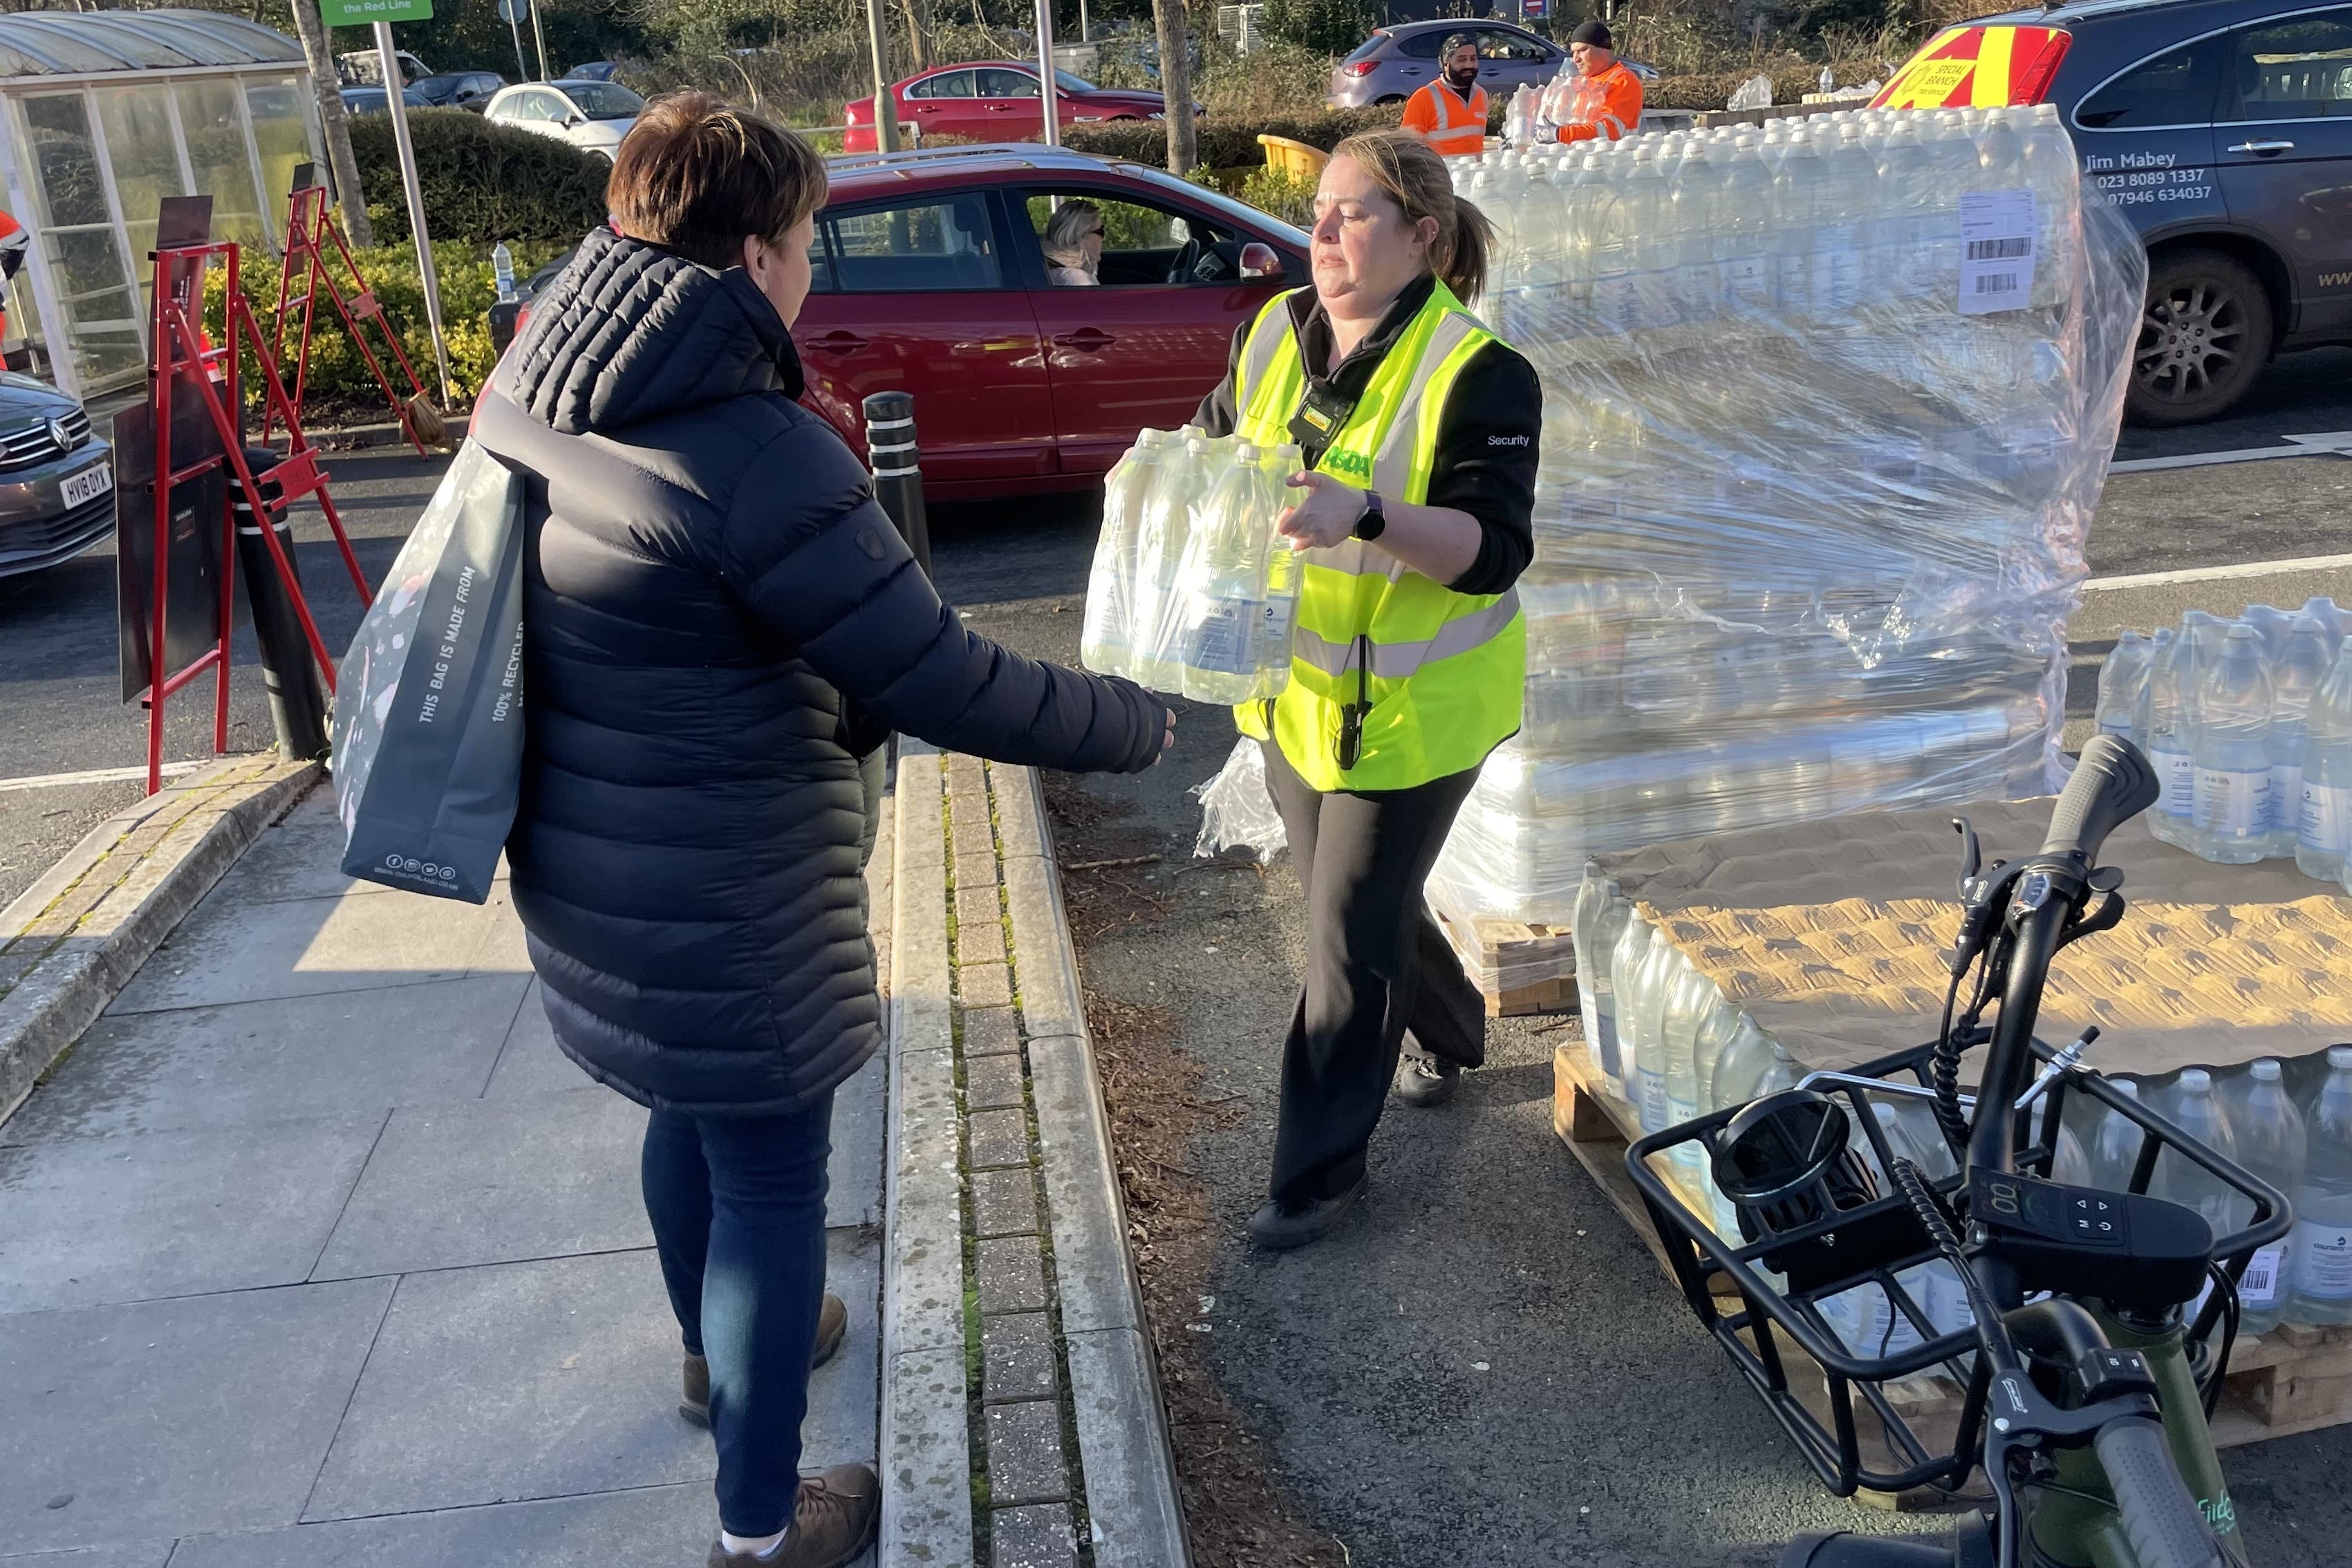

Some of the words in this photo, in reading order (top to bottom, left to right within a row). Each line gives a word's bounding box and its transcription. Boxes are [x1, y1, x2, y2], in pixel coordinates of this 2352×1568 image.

[344, 3, 361, 13] the
[364, 1, 386, 11] Red
[389, 0, 411, 10] Line
[1936, 64, 1966, 75] SPECIAL
[1925, 76, 1959, 86] BRANCH
[2084, 155, 2113, 172] Jim
[2120, 151, 2176, 169] Mabey
[2098, 175, 2125, 189] 023
[2129, 172, 2165, 186] 8089
[2169, 169, 2205, 183] 1337
[2108, 190, 2154, 205] 07946
[2158, 186, 2212, 201] 634037
[1487, 434, 1529, 447] Security
[1323, 446, 1370, 477] ASDA
[67, 476, 90, 503] HV18
[456, 566, 476, 604] FROM
[444, 605, 465, 643] MADE
[439, 644, 454, 658] IS
[429, 662, 449, 690] BAG
[419, 693, 440, 723] THIS
[492, 692, 512, 722] 100%
